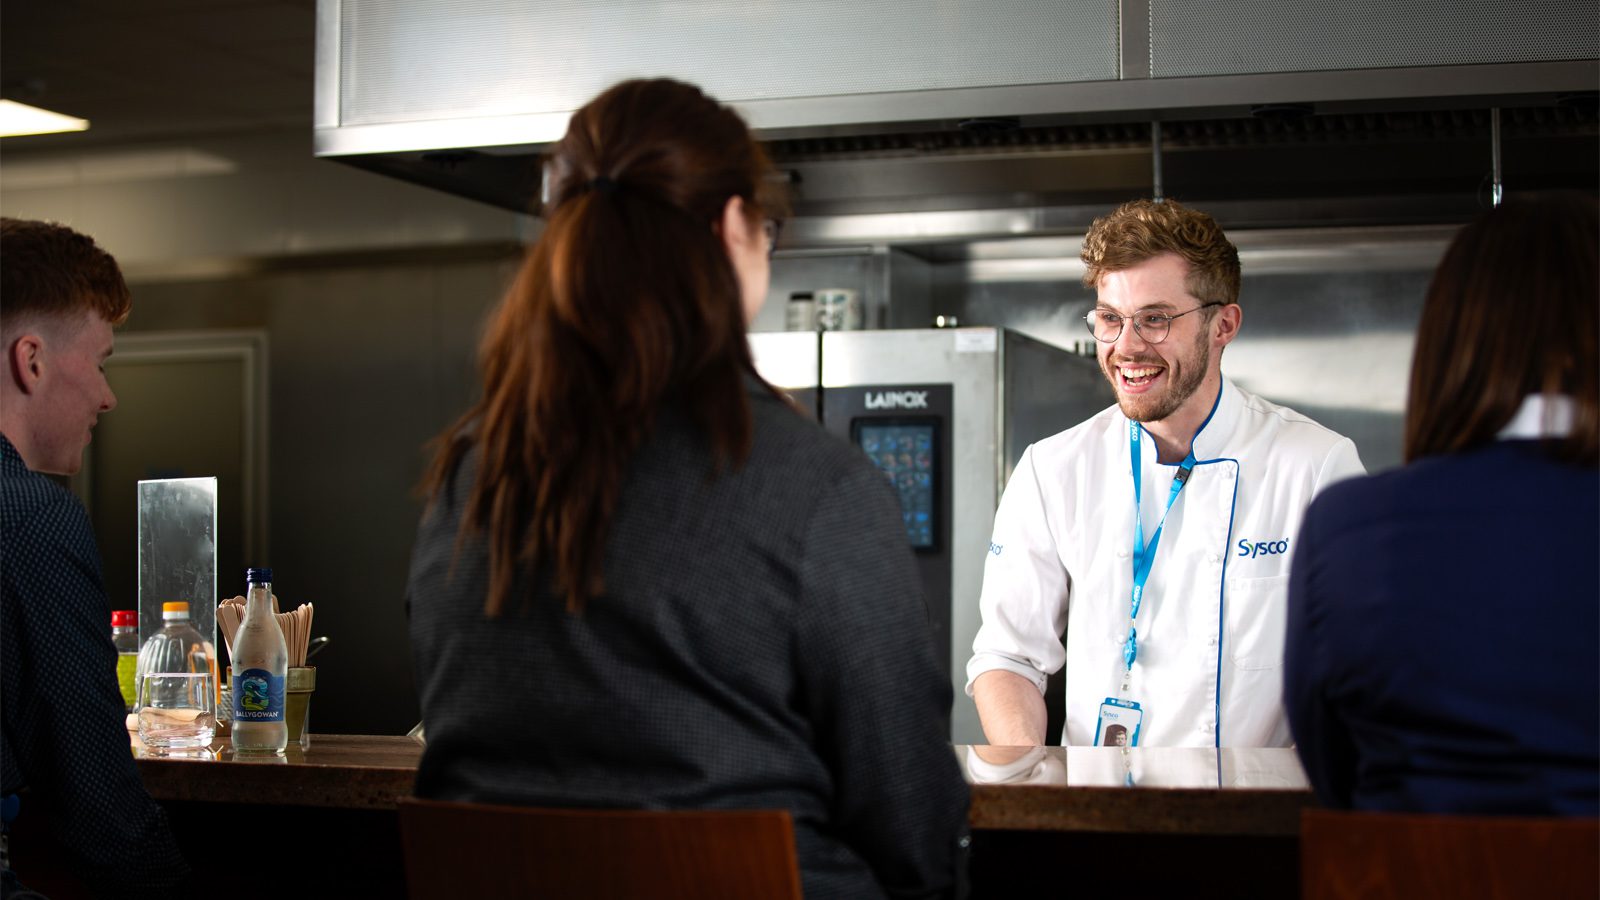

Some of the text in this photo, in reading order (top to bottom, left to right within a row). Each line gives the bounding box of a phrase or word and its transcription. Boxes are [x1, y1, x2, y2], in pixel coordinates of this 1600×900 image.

[865, 391, 929, 410] LAINOX
[989, 542, 1002, 556] sco
[1238, 538, 1288, 559] Sysco
